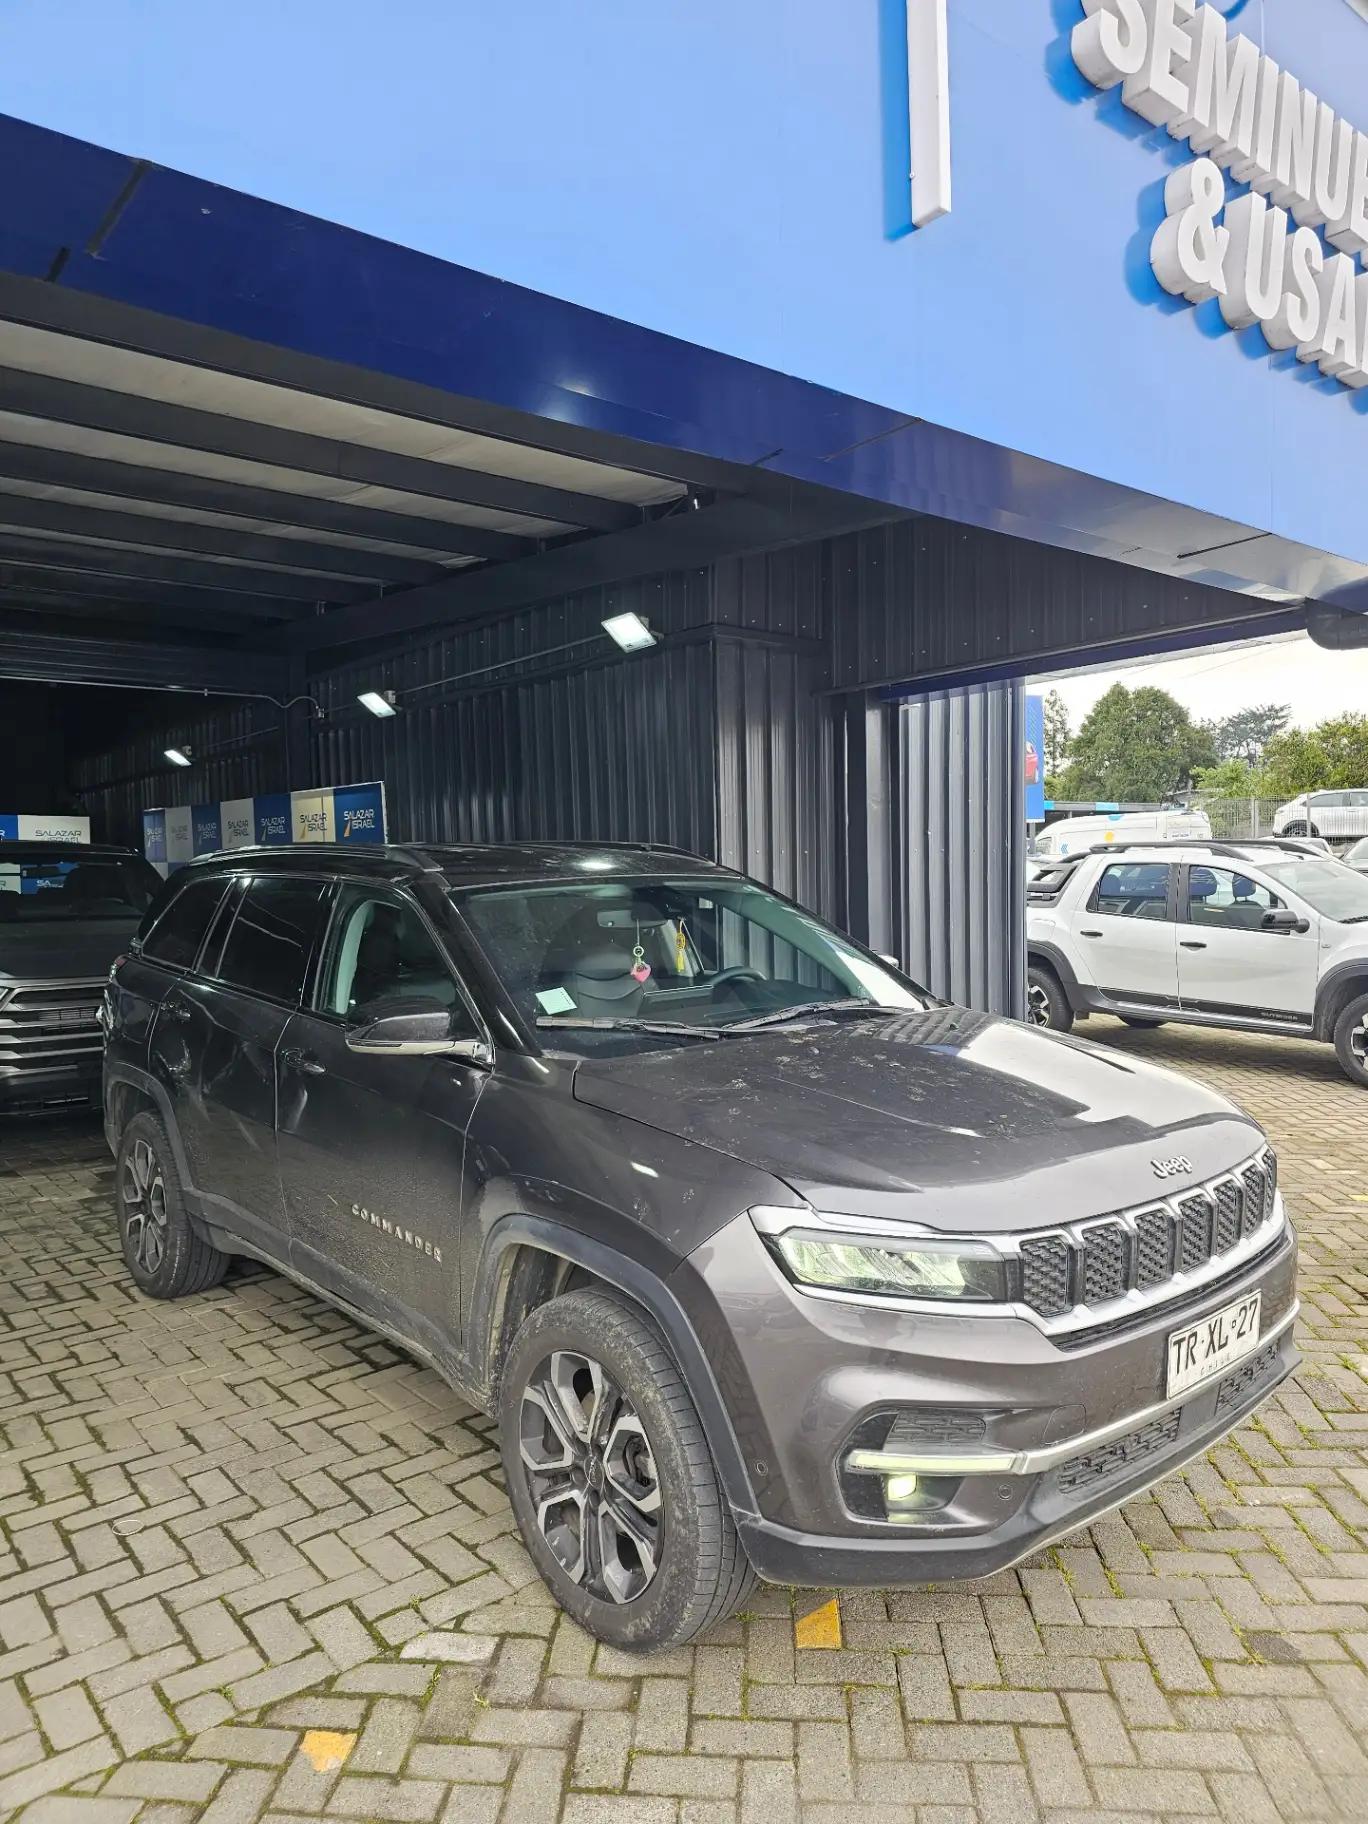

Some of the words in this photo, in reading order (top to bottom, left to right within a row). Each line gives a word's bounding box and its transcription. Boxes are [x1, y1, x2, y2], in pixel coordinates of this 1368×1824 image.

[1160, 157, 1230, 298] &
[1238, 191, 1368, 378] USA
[300, 812, 327, 823] SALAZAR
[344, 809, 375, 820] SALAZAR
[261, 816, 286, 826] SALAZAR
[352, 819, 375, 829] ISRAEL
[307, 822, 328, 832] ISRAEL
[35, 829, 82, 837] SALAZAR
[1150, 1155, 1192, 1179] Jeep
[351, 1203, 442, 1263] COMMANDER
